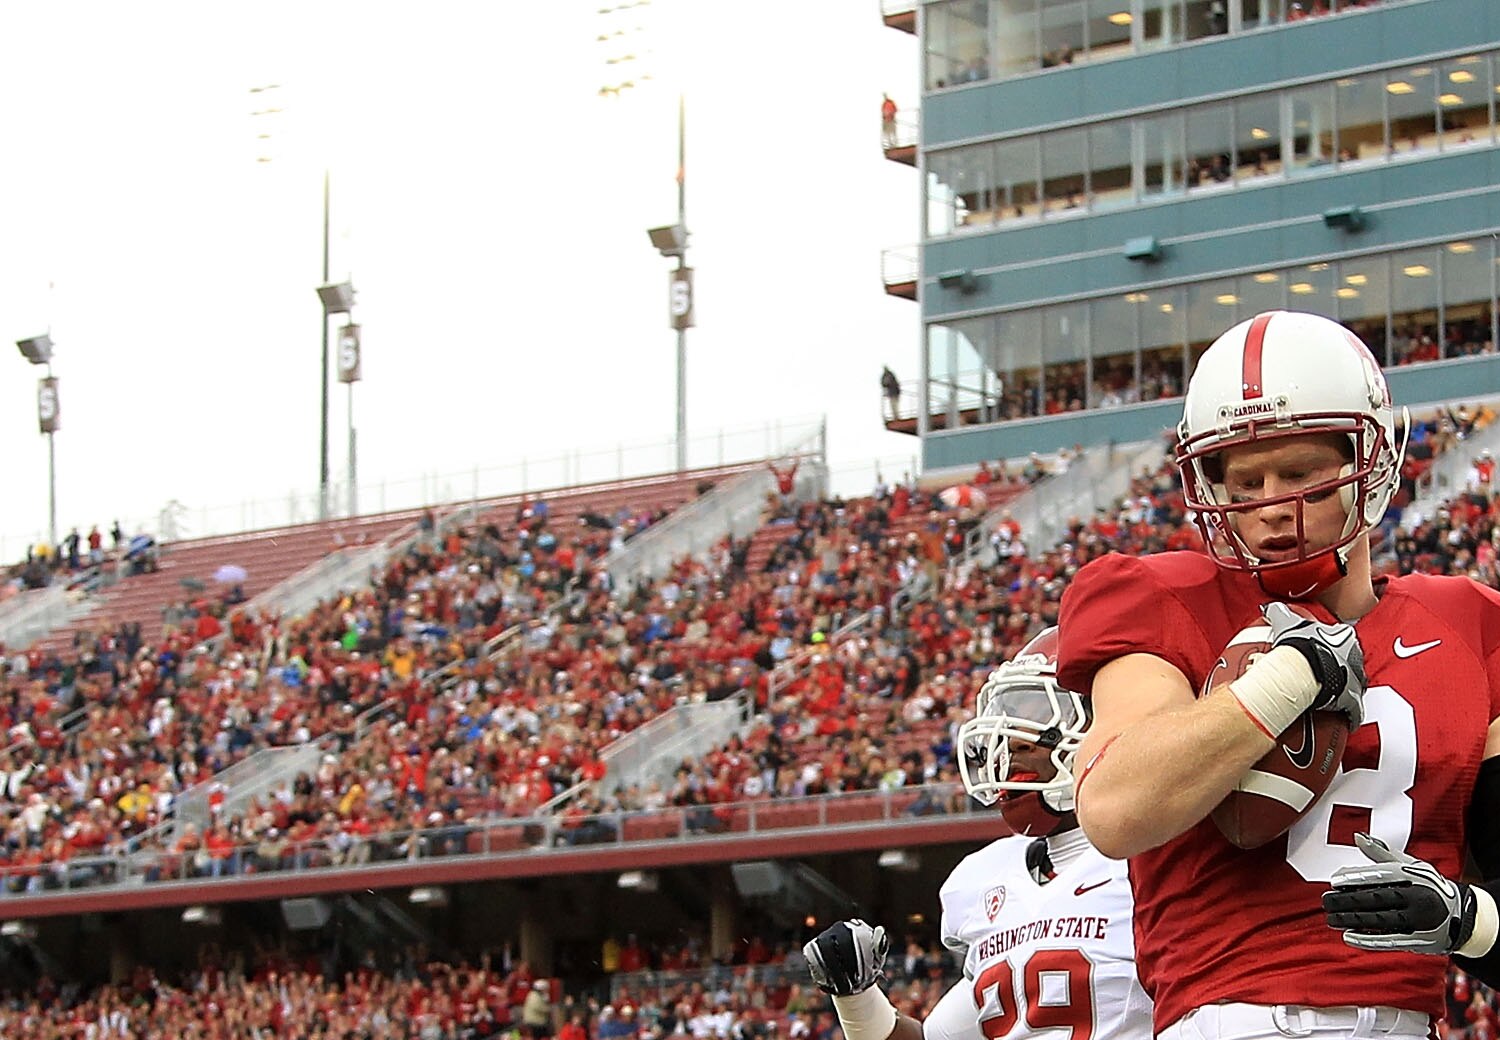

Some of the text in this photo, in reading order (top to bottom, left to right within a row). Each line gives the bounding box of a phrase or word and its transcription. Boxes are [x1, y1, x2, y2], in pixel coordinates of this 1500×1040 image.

[1234, 403, 1274, 417] CARDINAL
[978, 917, 1109, 961] WASHINGTON STATE
